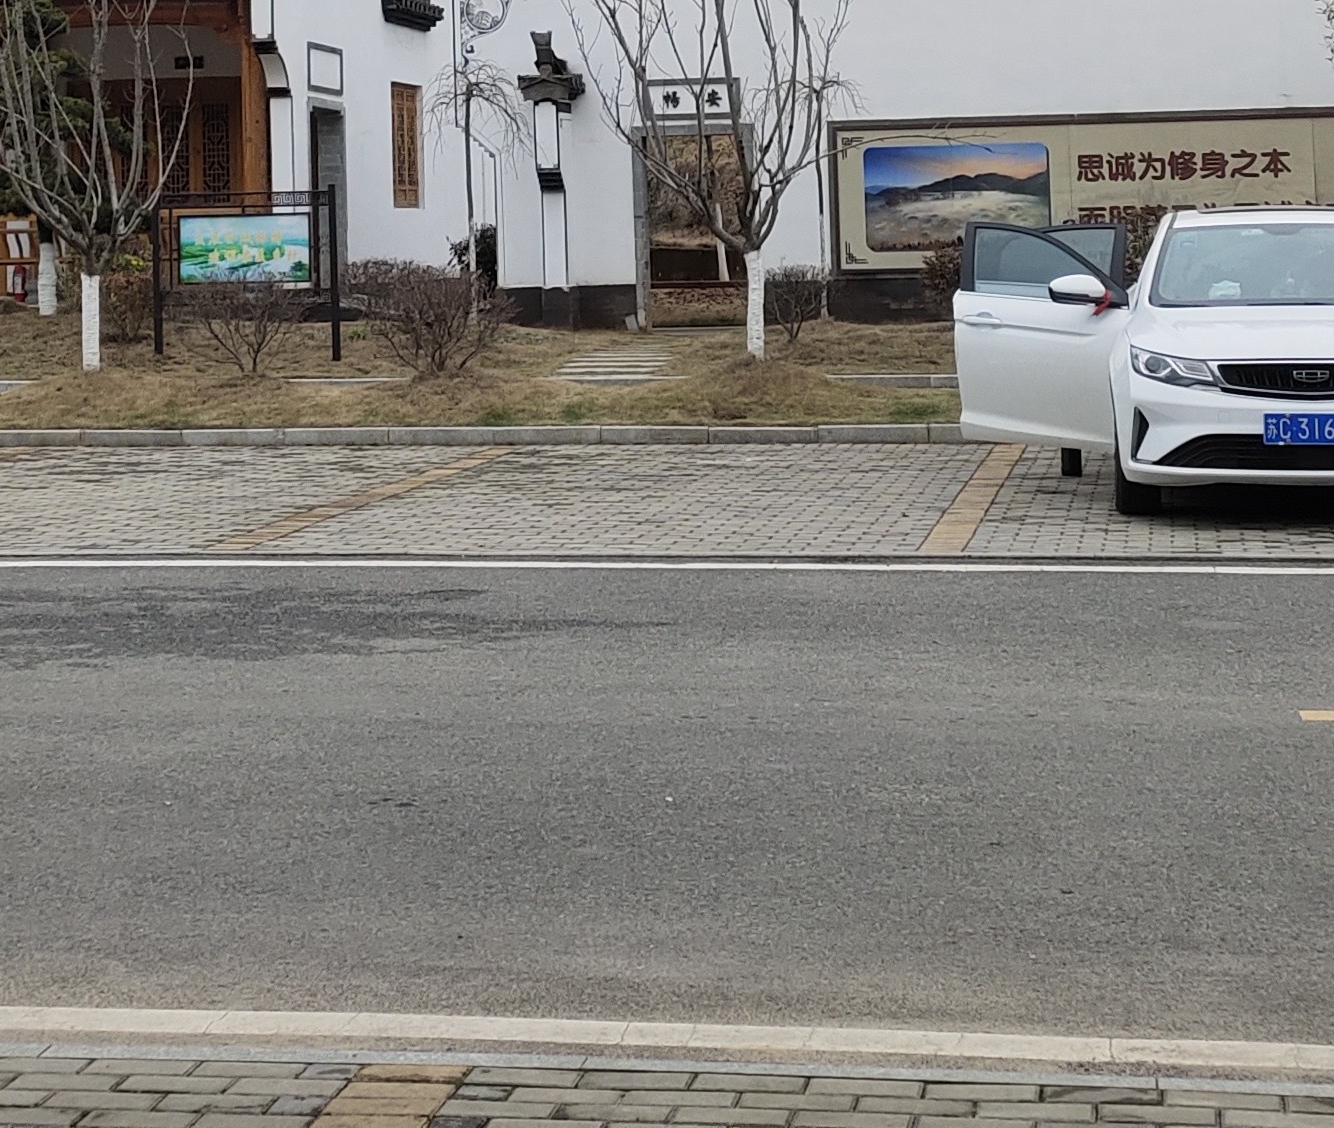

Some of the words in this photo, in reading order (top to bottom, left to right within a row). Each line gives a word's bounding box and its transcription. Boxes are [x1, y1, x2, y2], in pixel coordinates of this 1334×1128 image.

[1076, 148, 1292, 182] 思诚为修身之本
